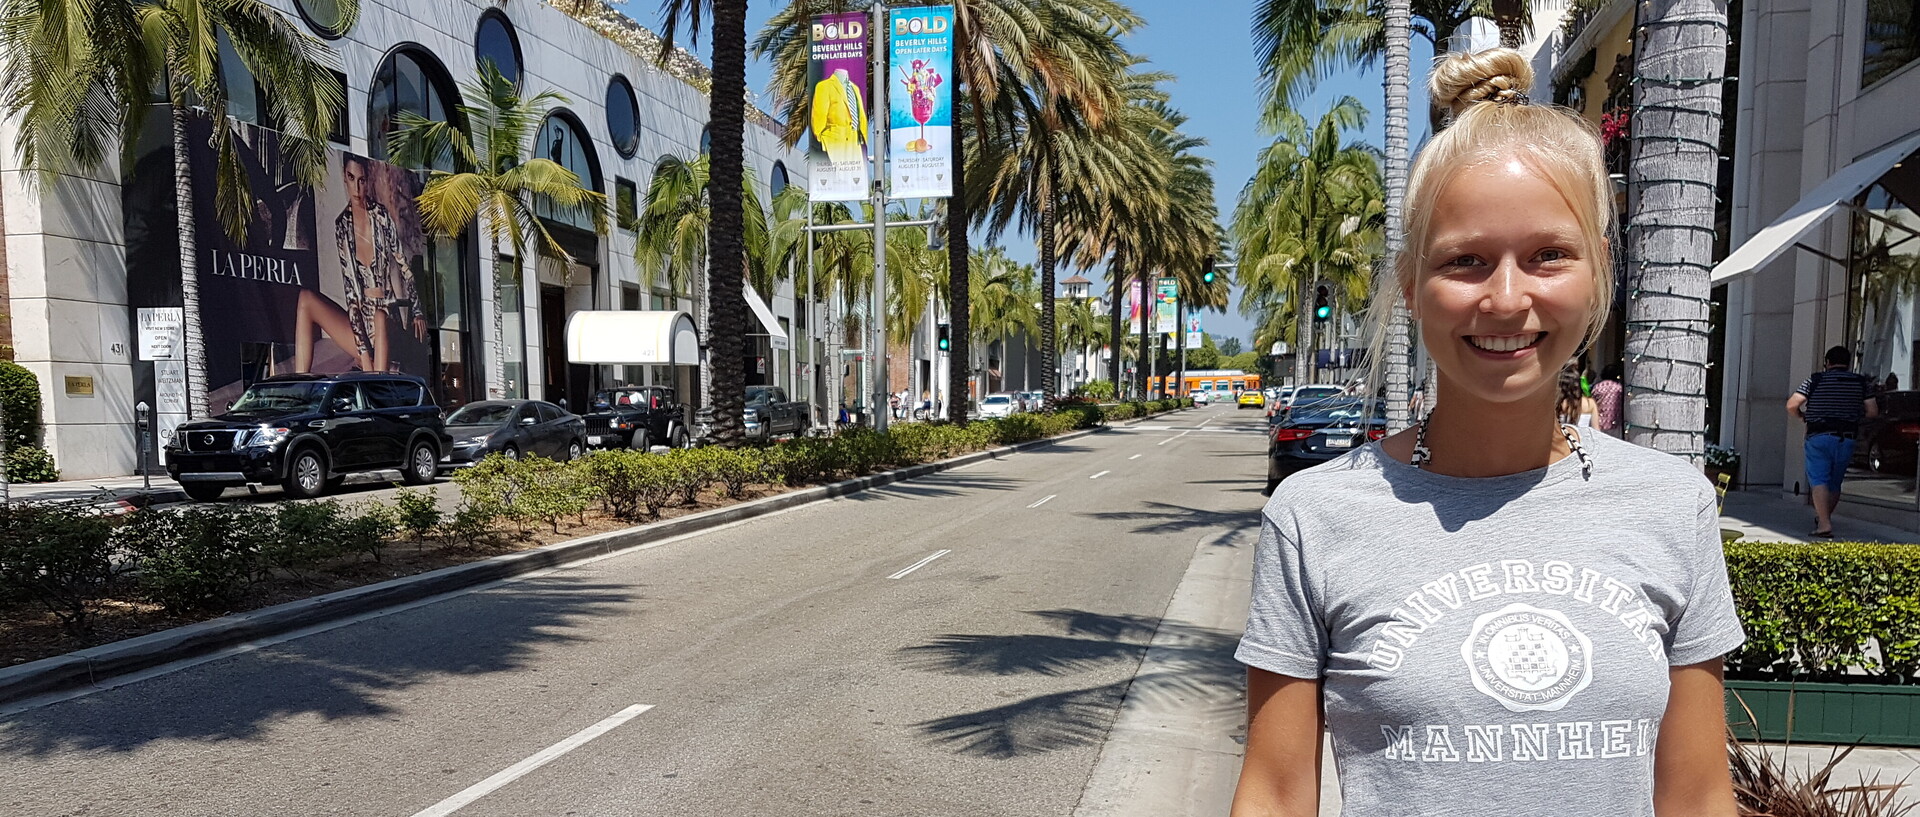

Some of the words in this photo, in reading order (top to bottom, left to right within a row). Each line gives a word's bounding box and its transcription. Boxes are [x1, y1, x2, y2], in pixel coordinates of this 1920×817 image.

[812, 21, 863, 41] BOLD
[895, 16, 948, 36] BOLD
[812, 43, 842, 53] BEVERLY
[843, 42, 863, 51] HILLS
[895, 38, 926, 47] BEVERLY
[927, 37, 947, 45] HILLS
[210, 248, 237, 278] LA
[239, 252, 303, 287] PERLA
[140, 313, 151, 321] LA
[152, 313, 181, 322] PERLA
[111, 343, 124, 355] 431
[1484, 613, 1529, 635] OMNIBUS
[1531, 613, 1571, 640] VERITAS
[1540, 659, 1582, 701] MANNHEIM
[1380, 718, 1656, 763] MANNHEI
